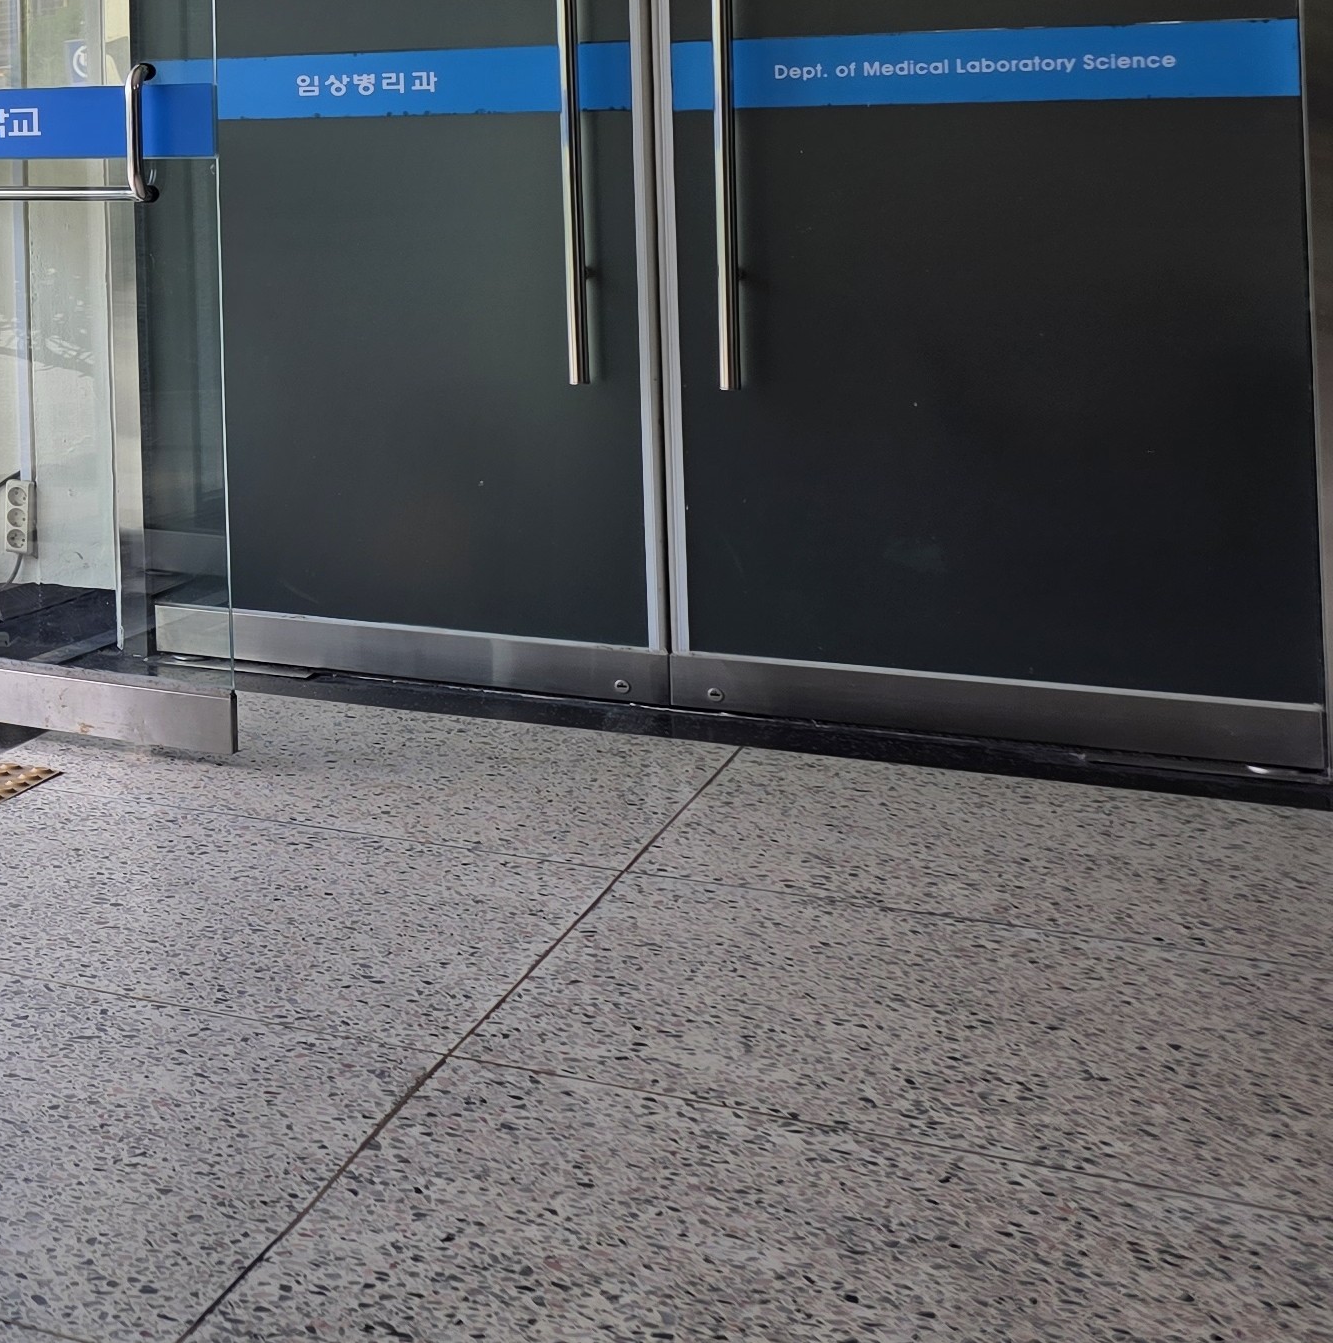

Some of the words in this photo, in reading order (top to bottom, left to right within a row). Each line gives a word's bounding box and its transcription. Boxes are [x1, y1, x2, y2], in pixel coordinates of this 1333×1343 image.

[774, 64, 828, 81] Dept.
[836, 61, 856, 78] of
[863, 58, 949, 77] Medical
[956, 56, 1076, 74] Laboratory
[1083, 53, 1176, 71] Science
[296, 71, 438, 97] 임상병리과
